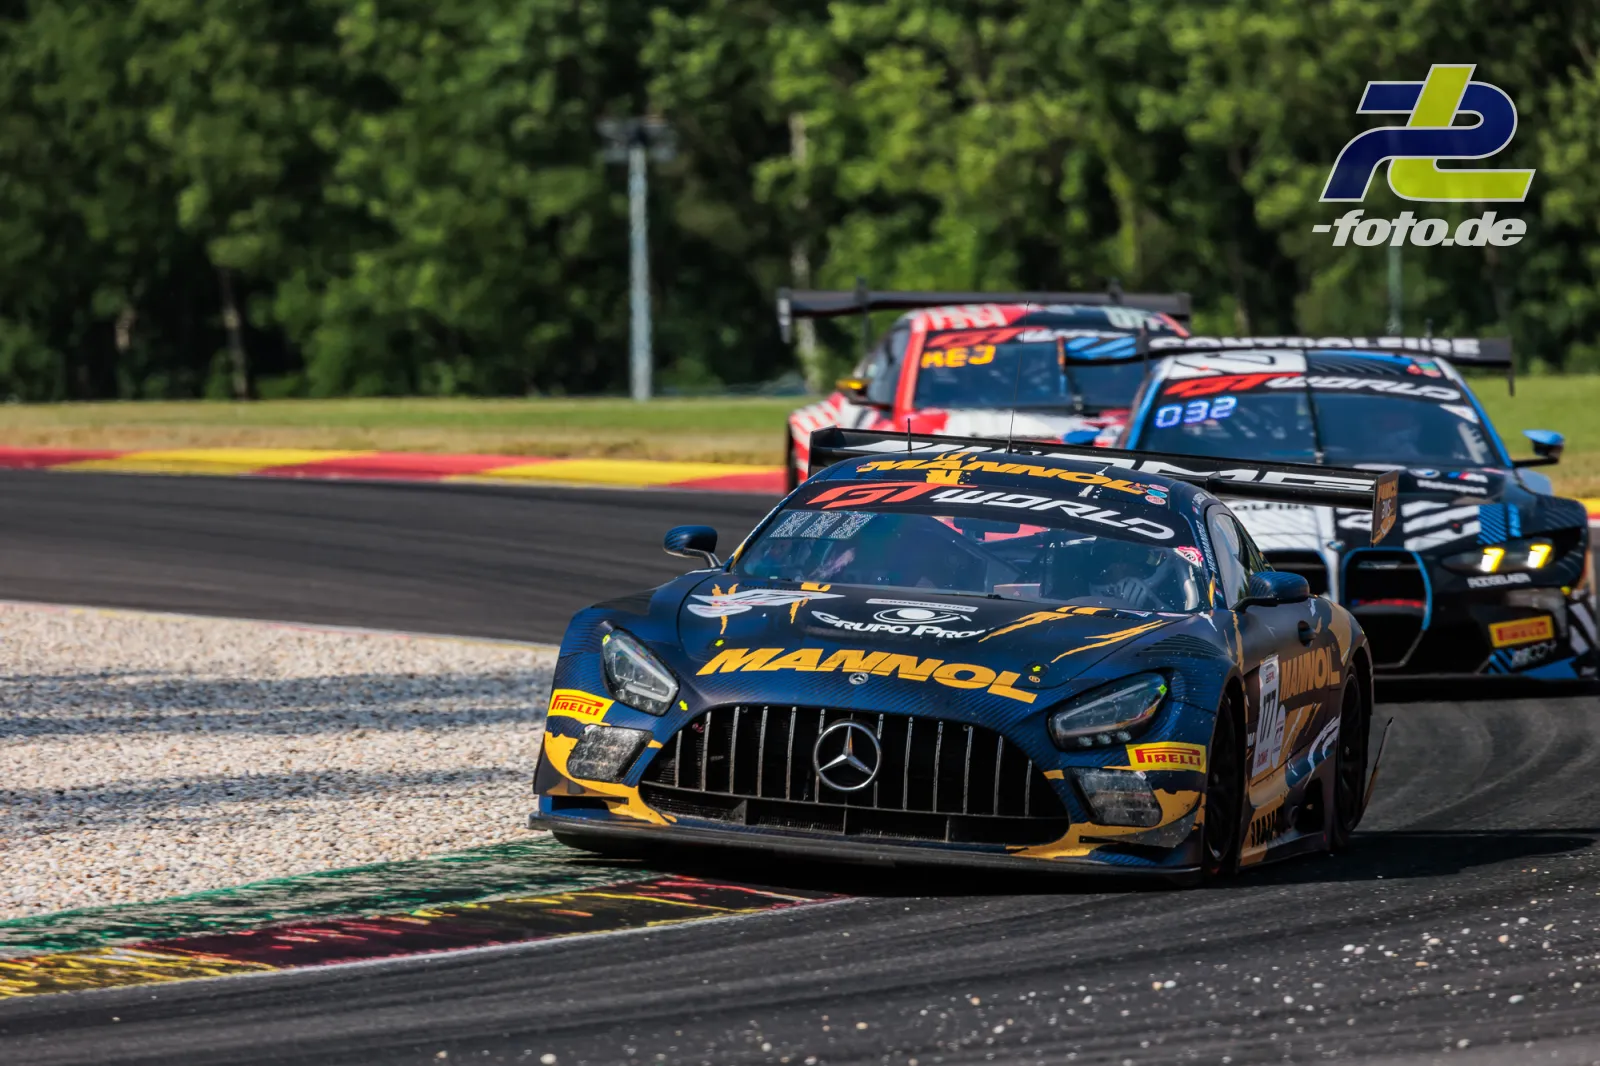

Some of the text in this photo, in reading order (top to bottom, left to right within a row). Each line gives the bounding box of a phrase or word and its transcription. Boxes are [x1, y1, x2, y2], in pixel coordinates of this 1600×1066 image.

[1164, 372, 1461, 400] GT WORLD
[1155, 396, 1237, 428] 032
[856, 459, 1145, 495] MANNOL
[806, 482, 978, 510] GT
[930, 488, 1175, 540] WORLD
[811, 610, 910, 635] GRUPO
[696, 647, 1038, 704] MANNOL
[1279, 646, 1341, 703] MANNOL
[551, 694, 604, 716] PIRELLI
[1134, 747, 1201, 766] PIRELLI
